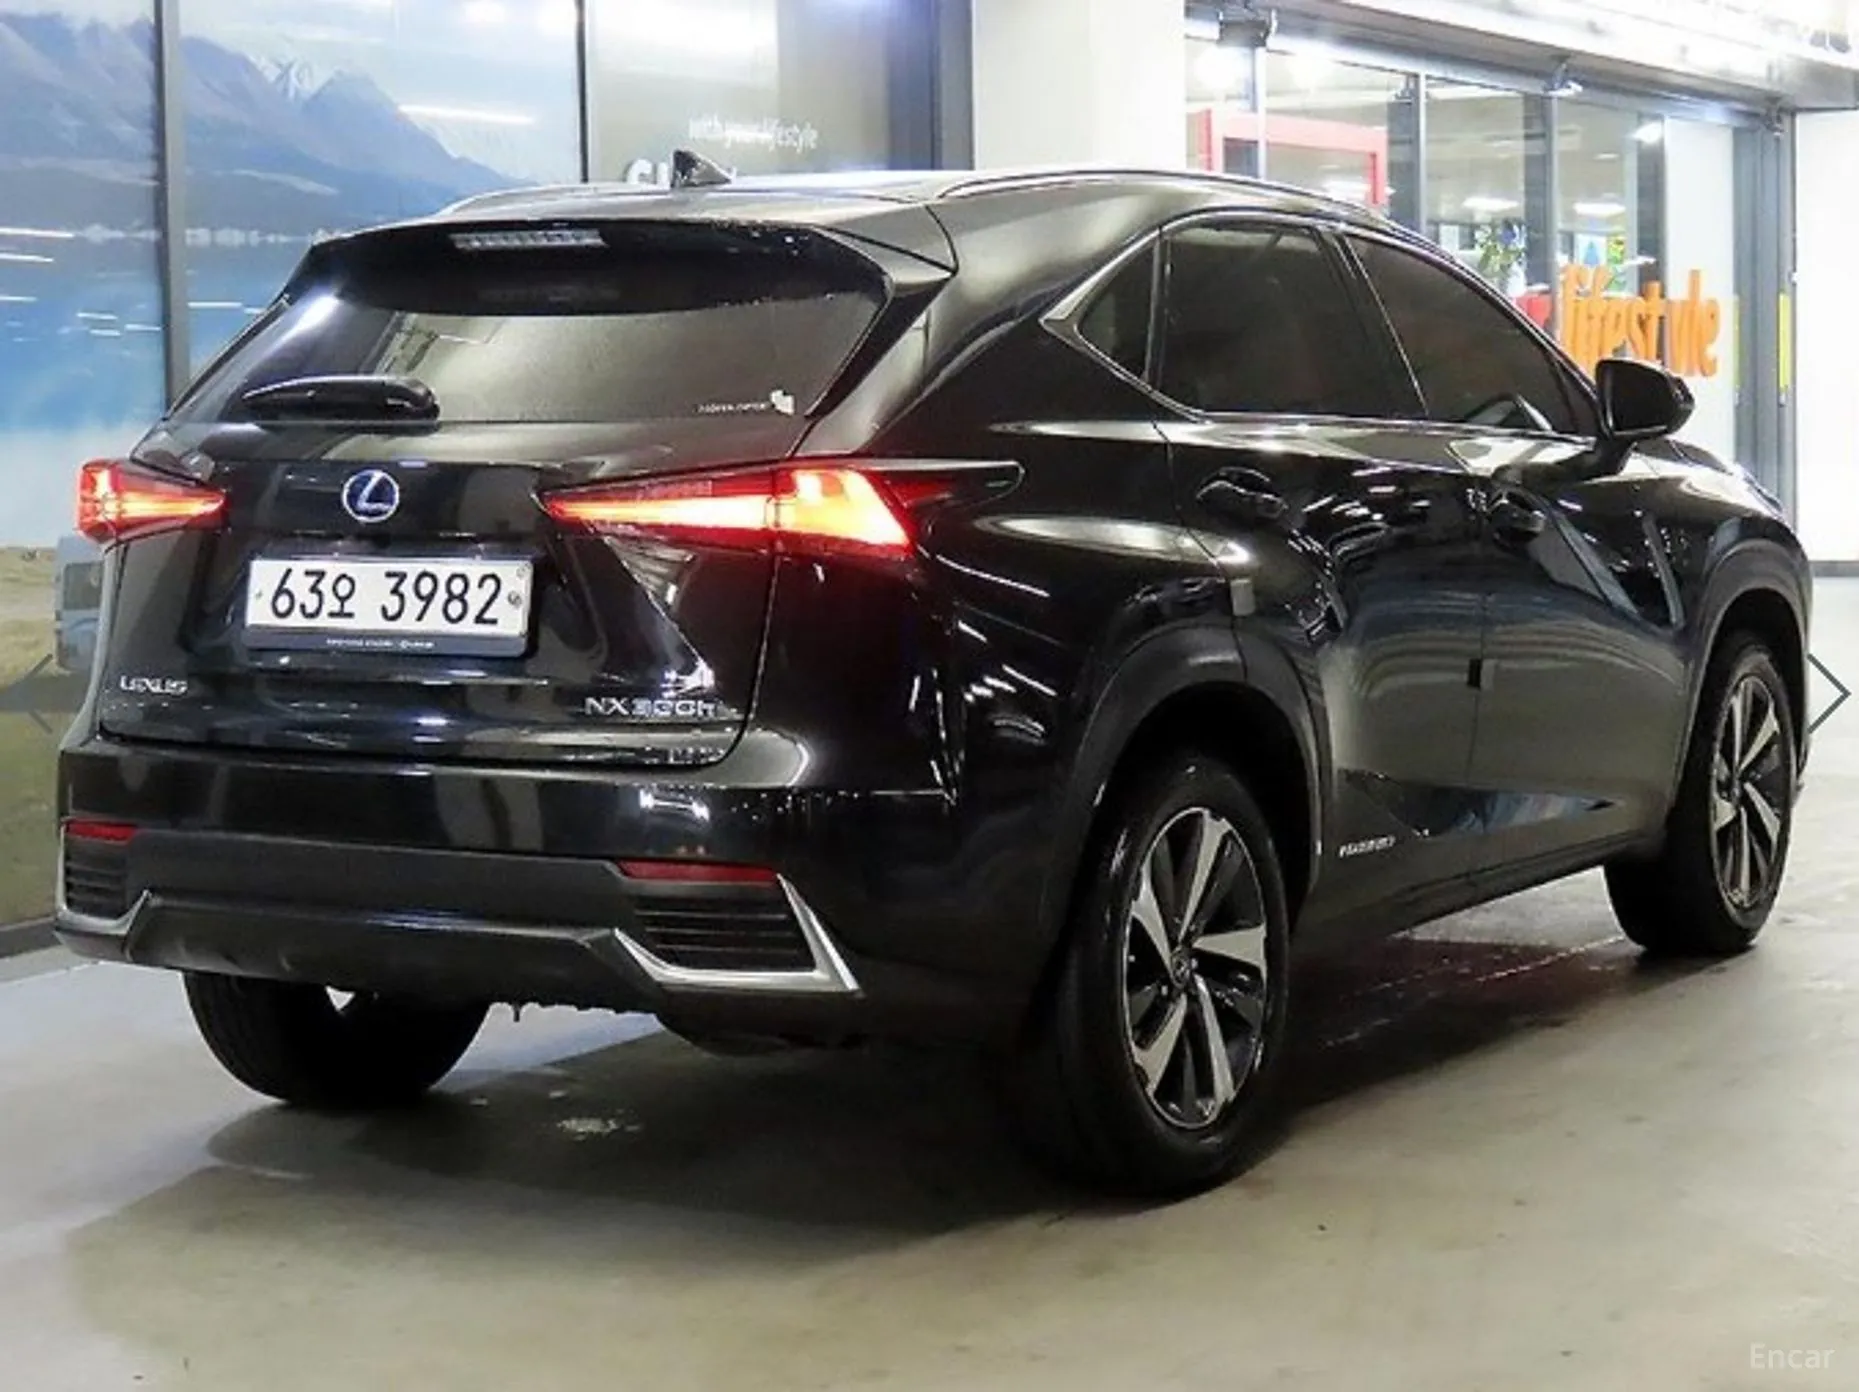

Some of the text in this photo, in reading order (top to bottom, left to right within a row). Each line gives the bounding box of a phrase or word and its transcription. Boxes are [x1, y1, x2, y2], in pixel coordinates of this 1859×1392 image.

[270, 567, 501, 625] 63오 3982
[120, 675, 188, 696] LEXUS
